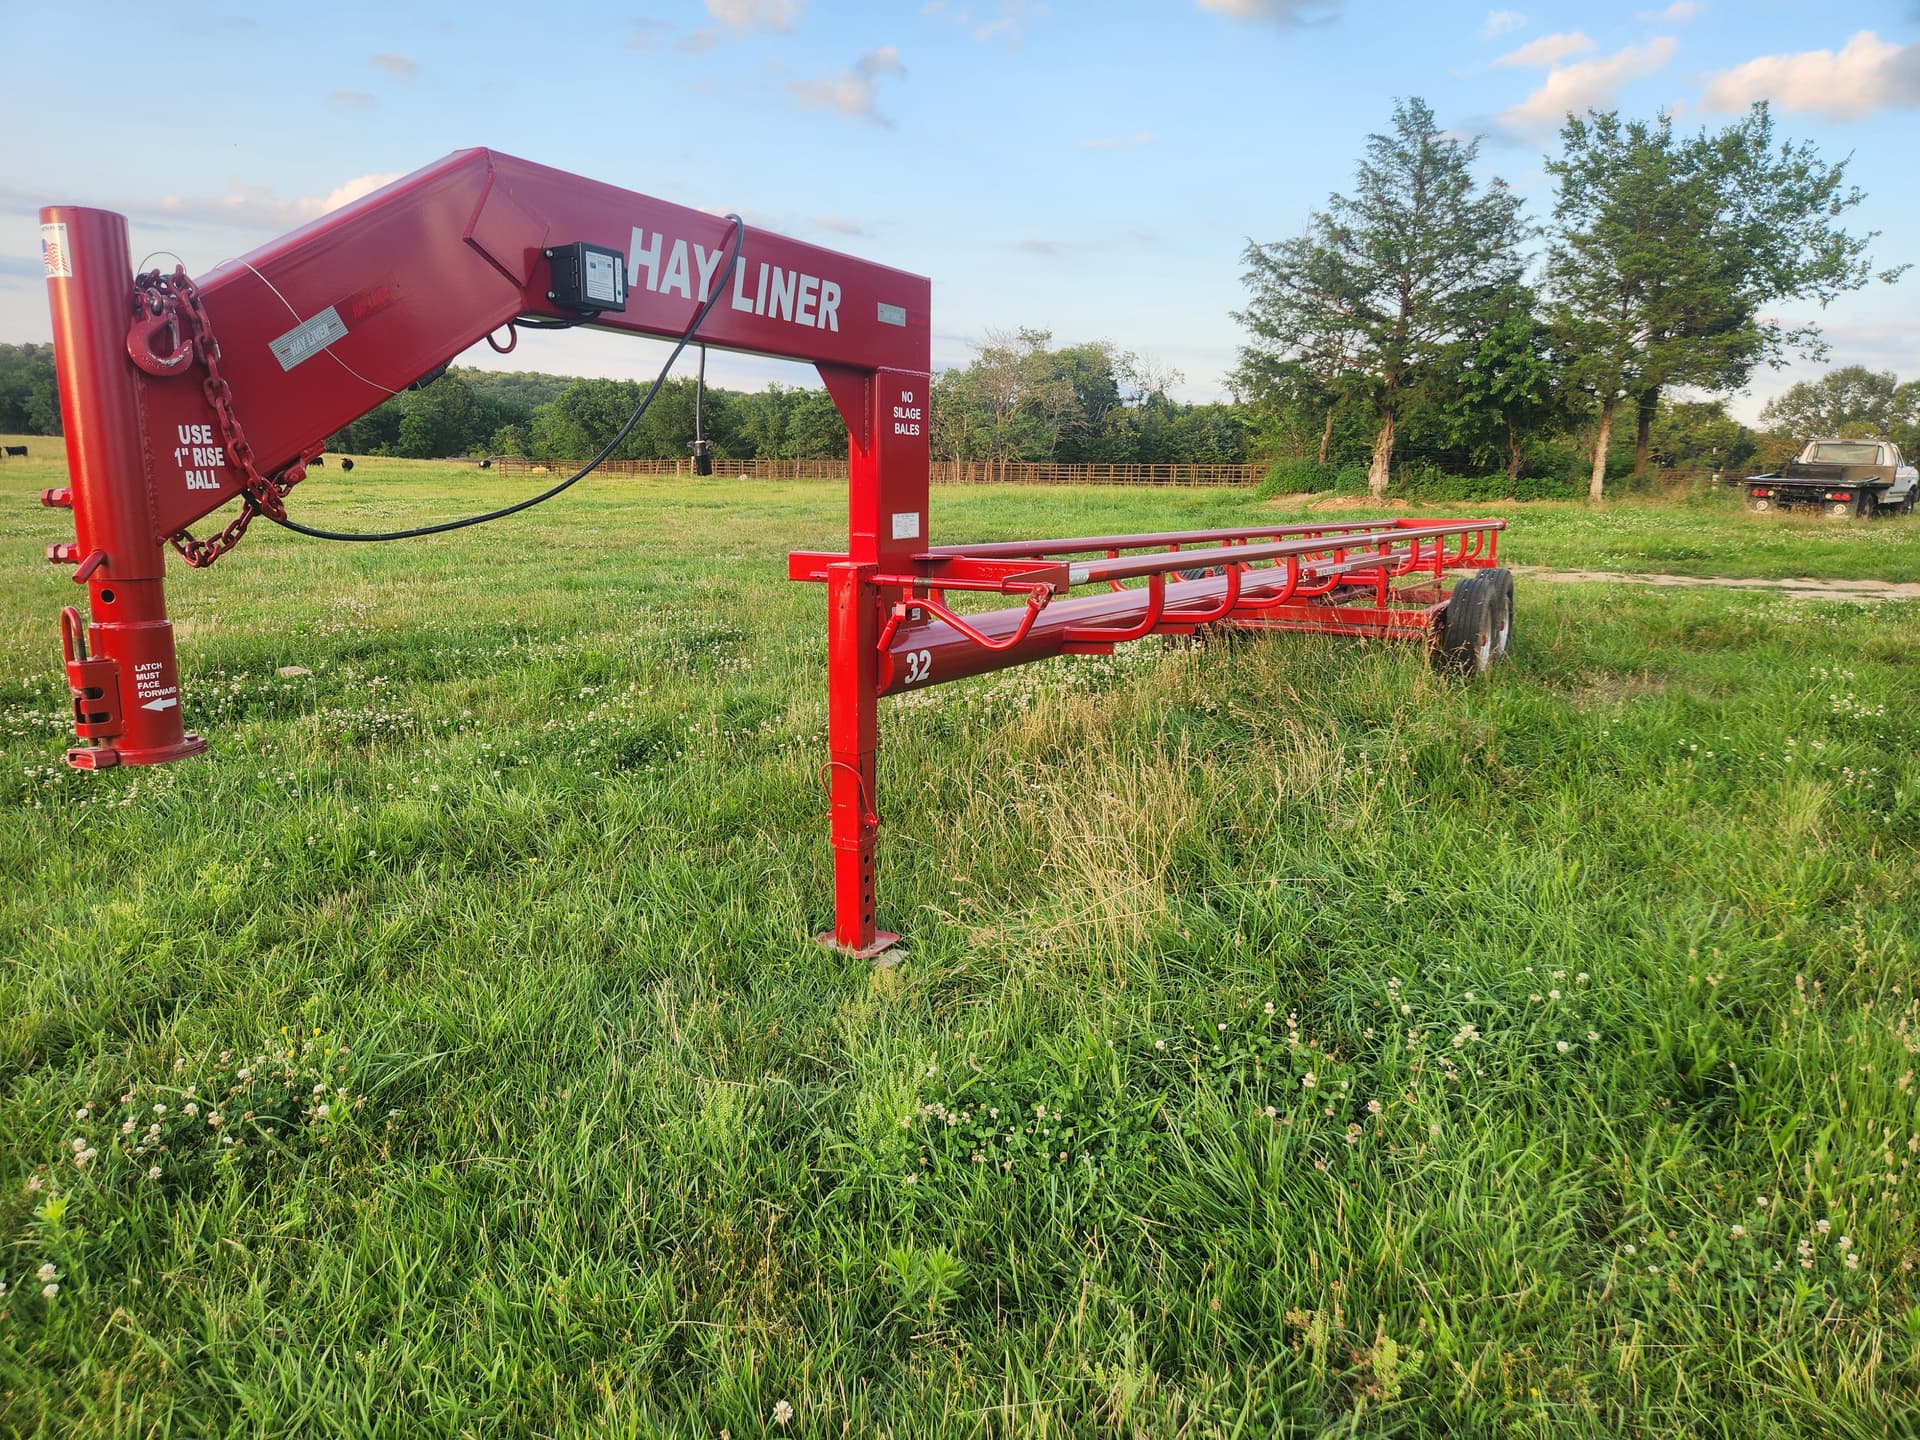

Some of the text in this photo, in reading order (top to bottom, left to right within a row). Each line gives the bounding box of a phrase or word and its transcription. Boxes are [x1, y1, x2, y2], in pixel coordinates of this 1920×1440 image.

[627, 226, 842, 333] HAY LINER
[901, 391, 914, 403] NO
[893, 406, 921, 420] SILAGE
[177, 424, 213, 445] USE
[894, 423, 920, 436] BALES
[174, 447, 225, 468] 1" RISE
[185, 469, 220, 490] BALL
[134, 662, 162, 672] LATCH
[904, 649, 932, 684] 32
[136, 672, 160, 681] MUST
[137, 680, 160, 689] FACE
[138, 686, 177, 699] FORWARD
